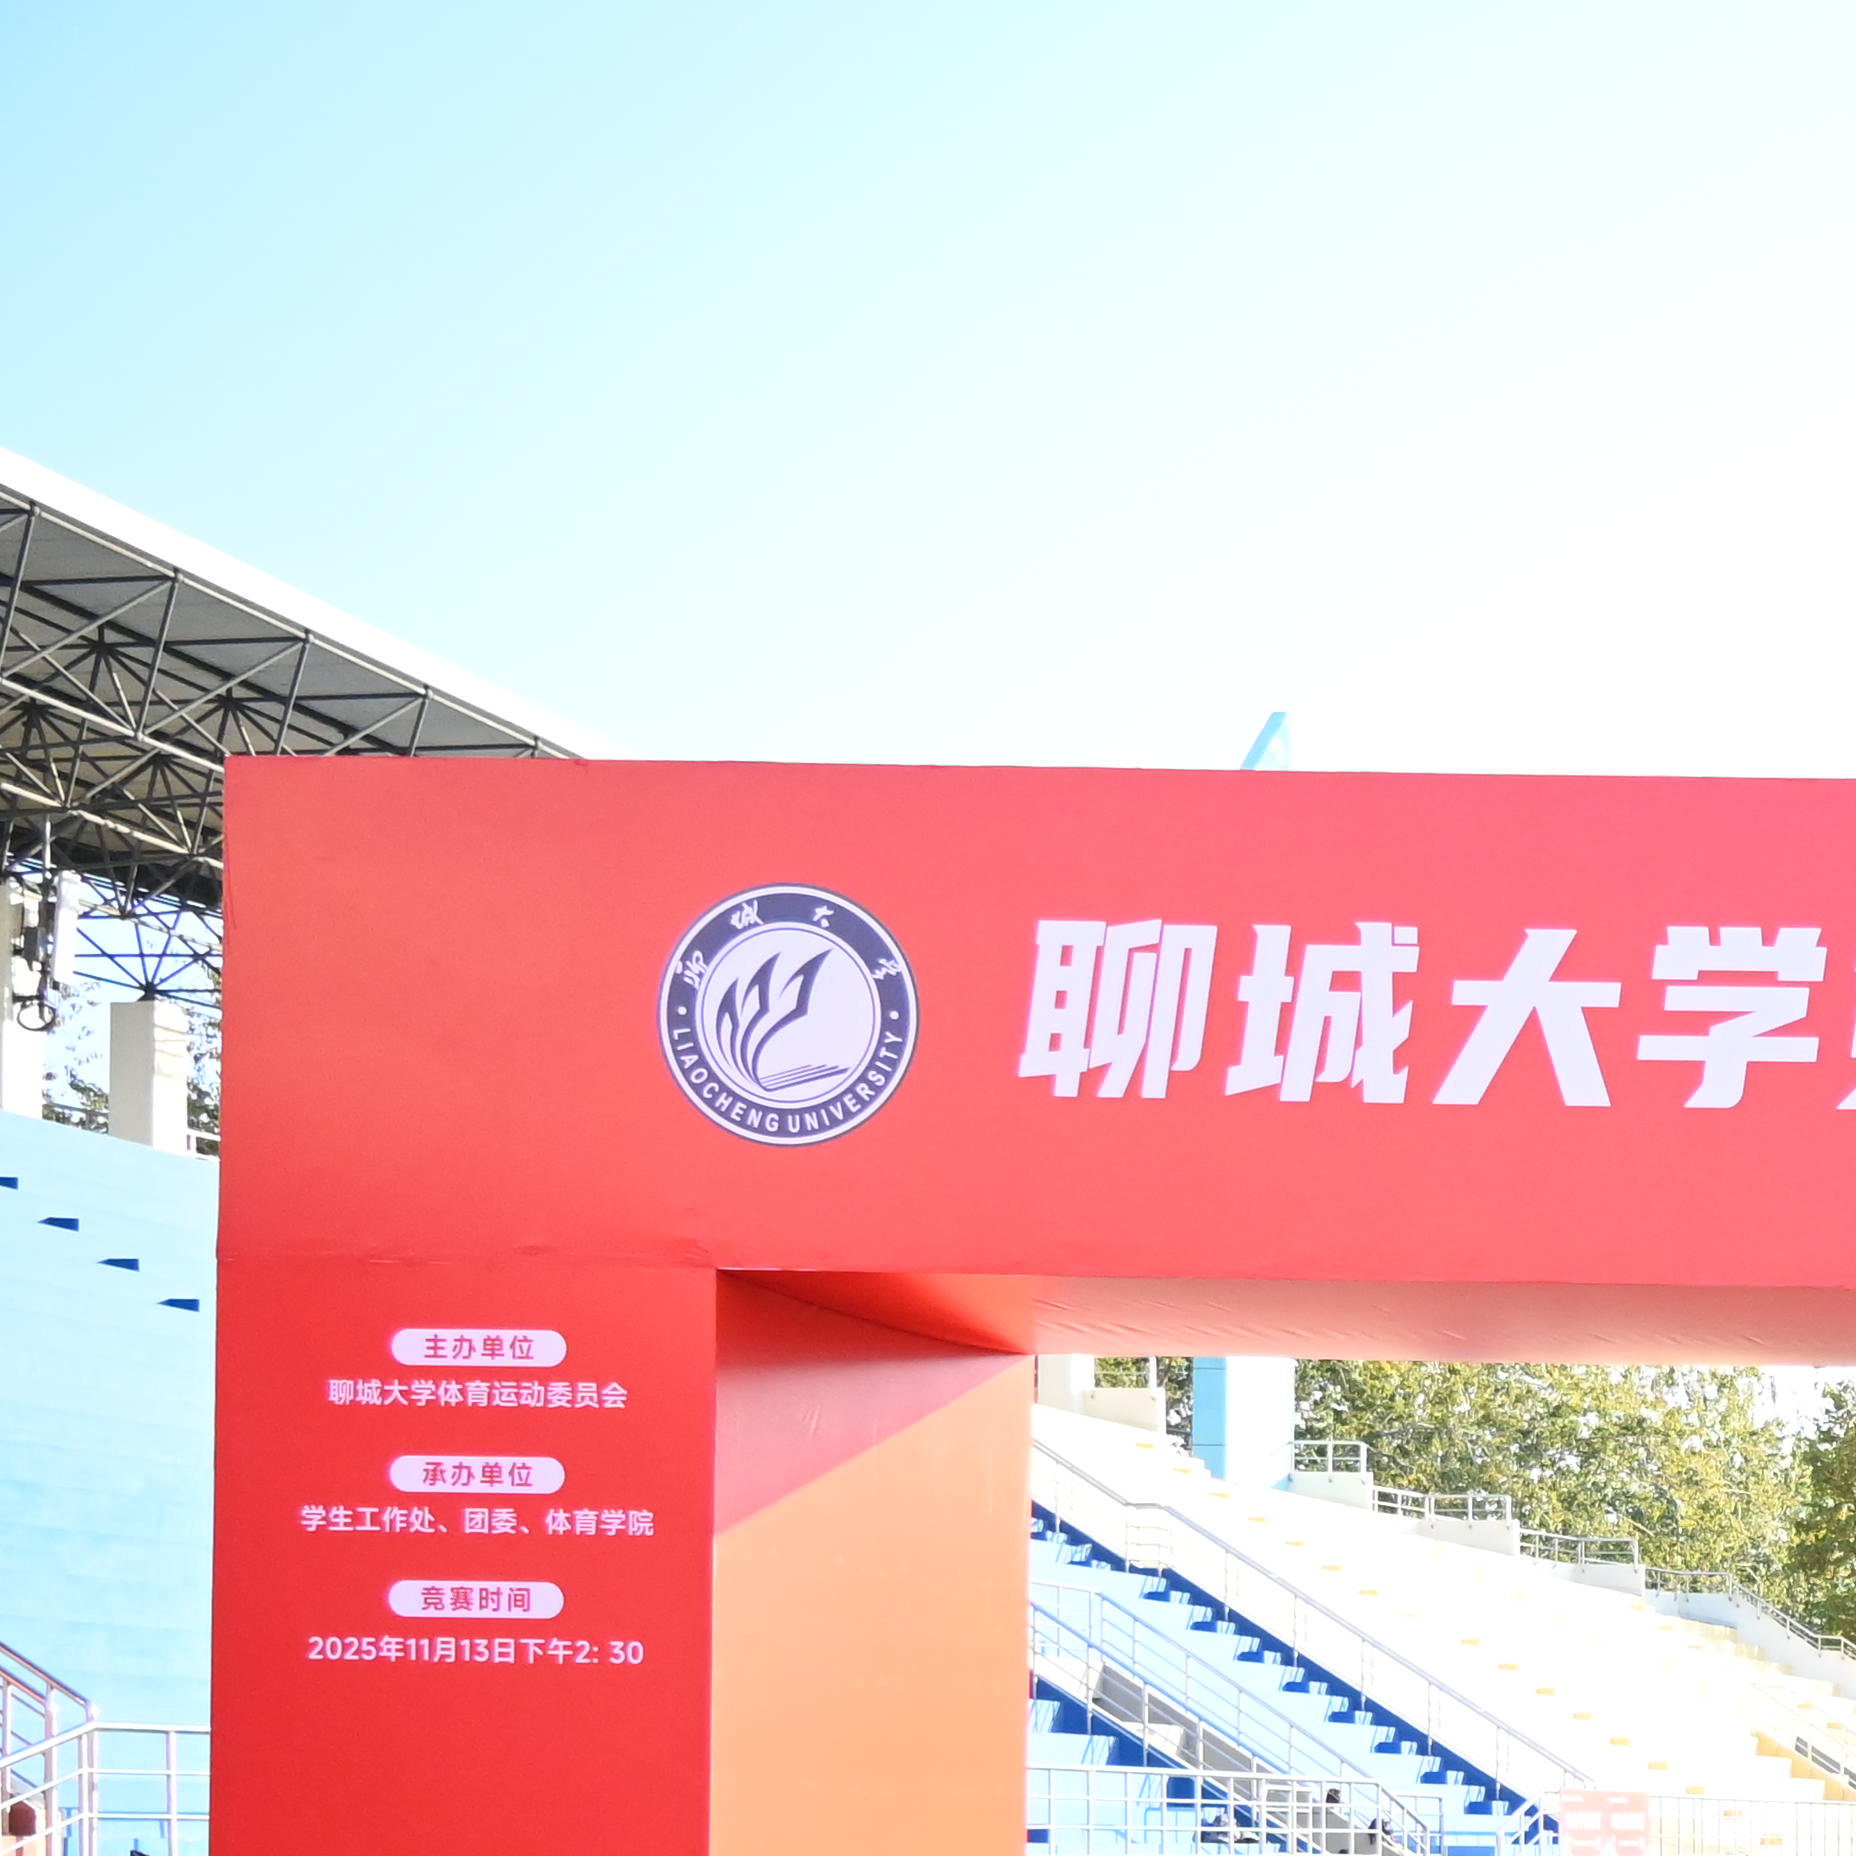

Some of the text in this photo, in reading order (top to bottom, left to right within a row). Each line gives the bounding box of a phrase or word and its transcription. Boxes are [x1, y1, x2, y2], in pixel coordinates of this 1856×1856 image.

[672, 1027, 903, 1134] LIAOCHENG UNIVERSITY
[424, 1334, 534, 1360] 主办单位
[328, 1378, 628, 1409] 聊城大学体育运动委员会
[422, 1461, 533, 1487] 承办单位
[301, 1505, 655, 1537] 学生工作处、团委、体育学院
[420, 1585, 532, 1613] 竞赛时间
